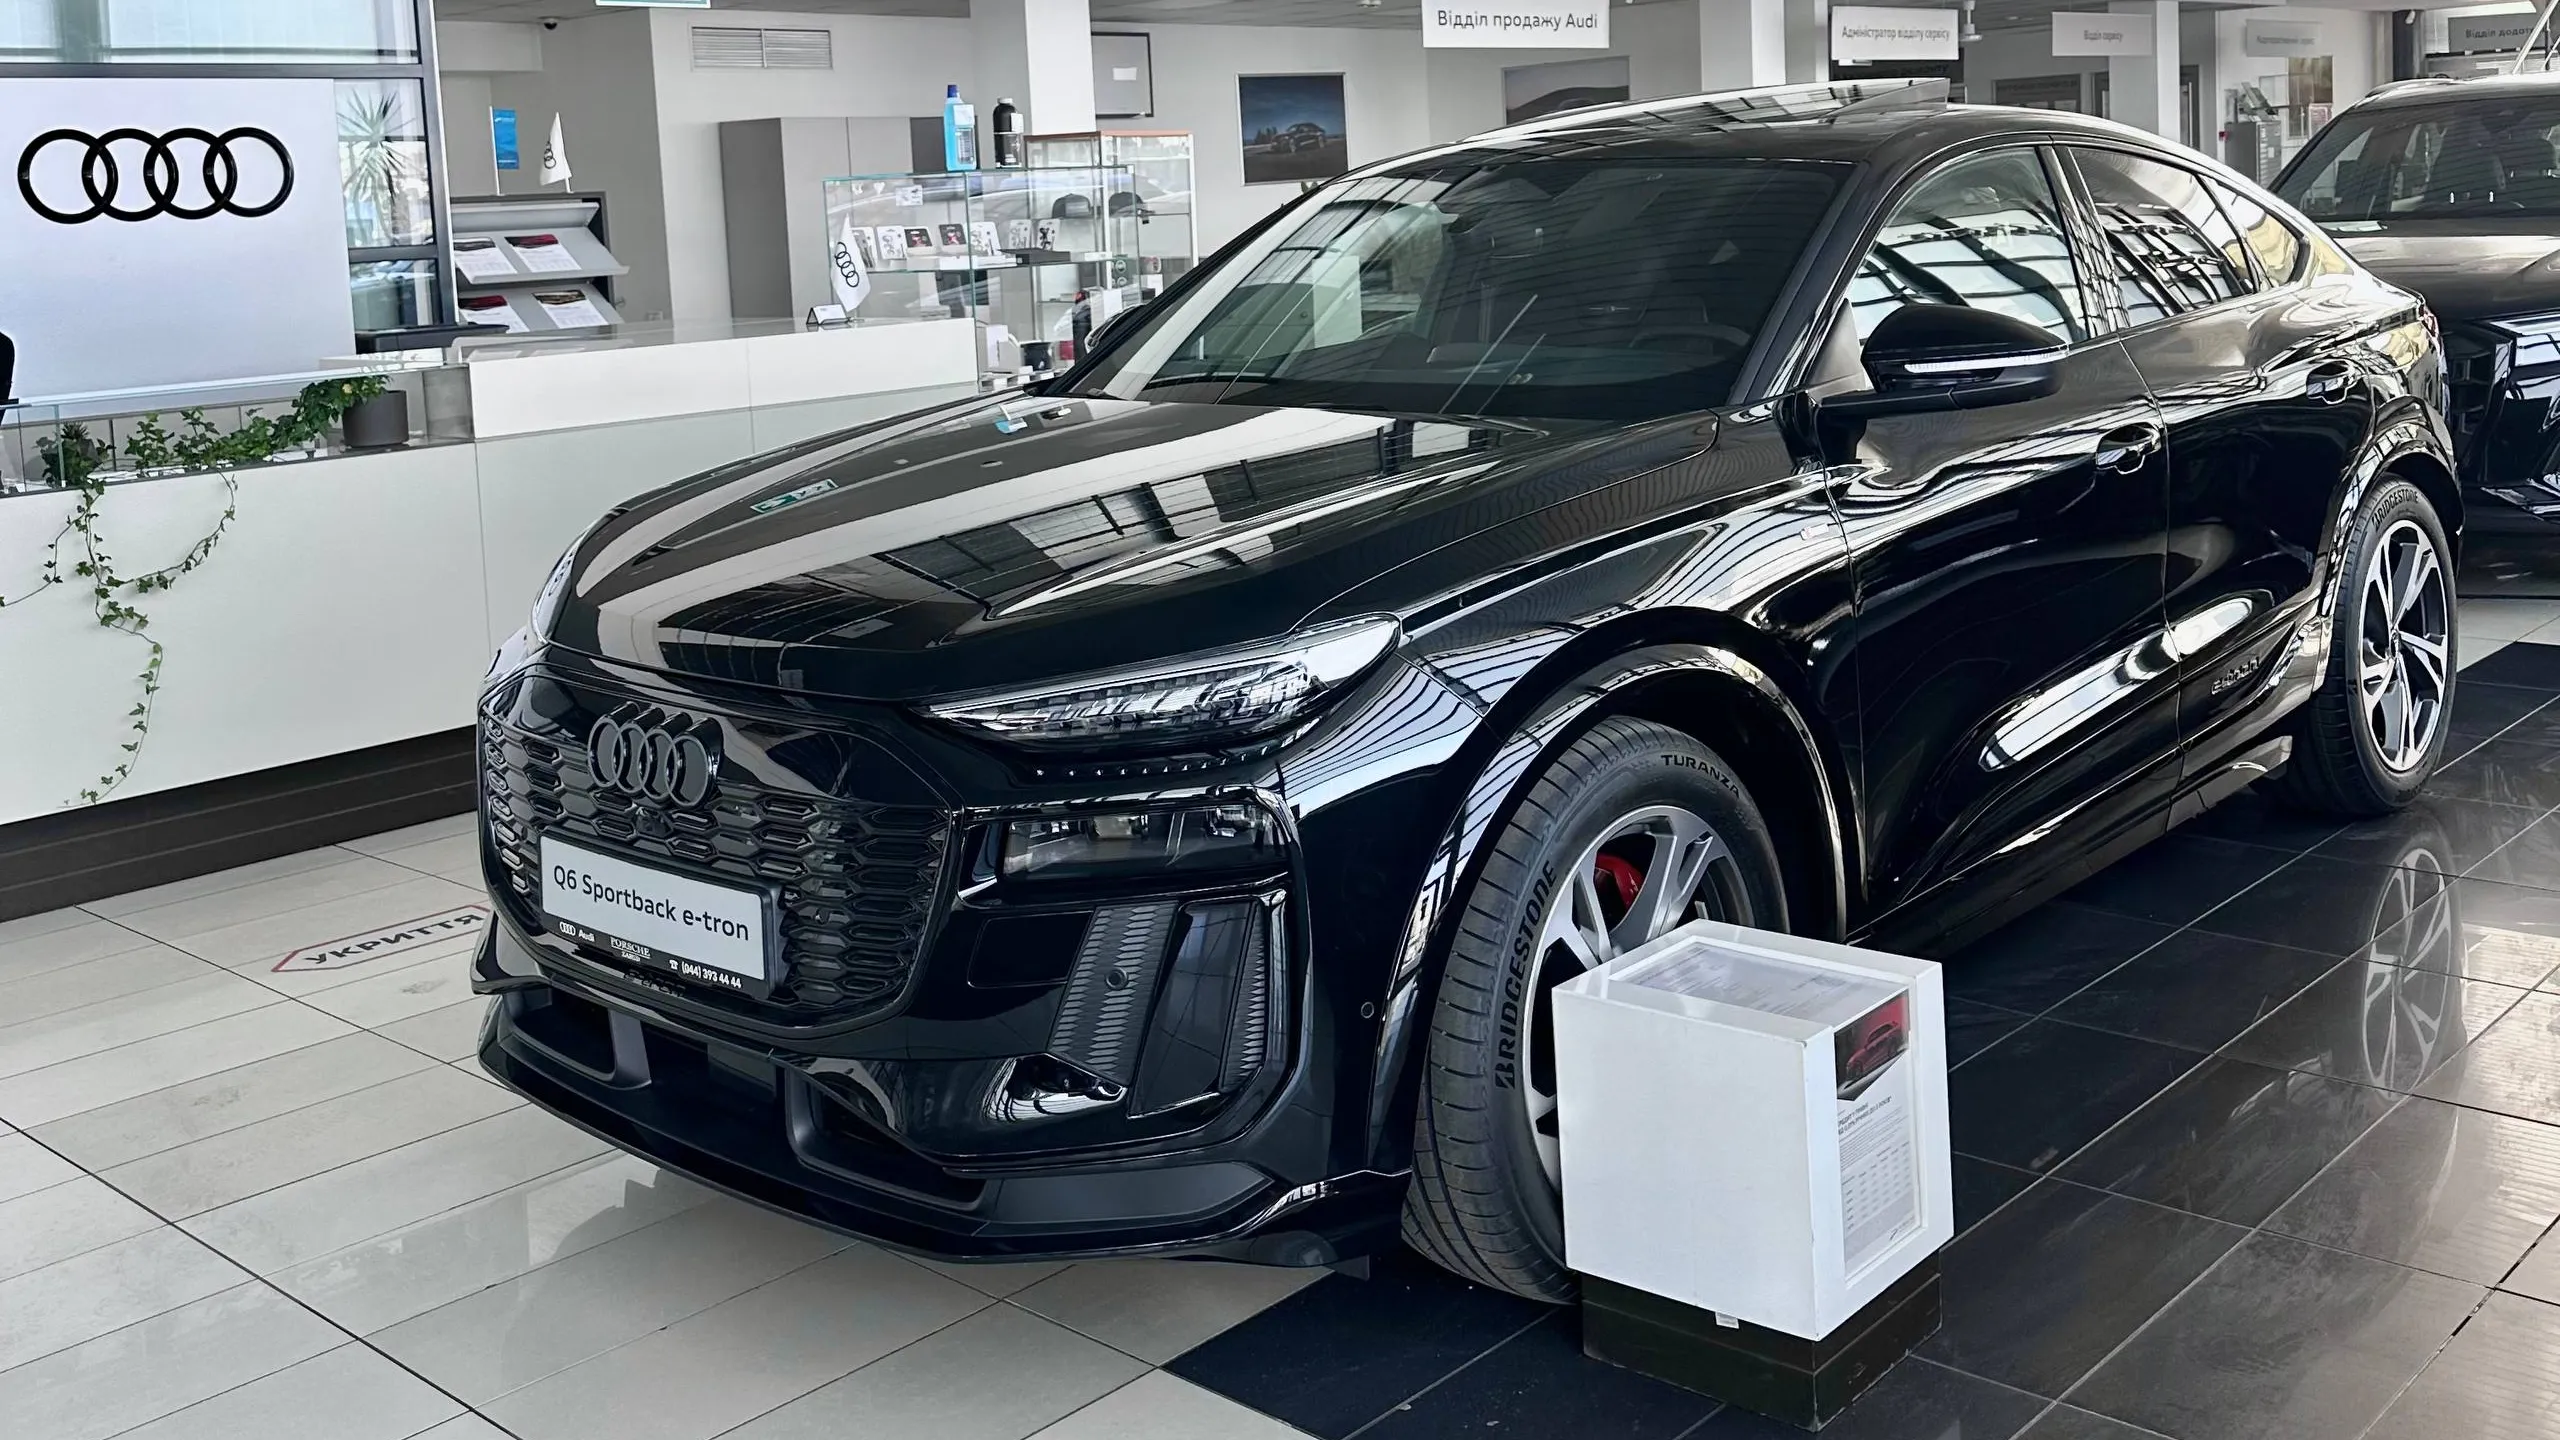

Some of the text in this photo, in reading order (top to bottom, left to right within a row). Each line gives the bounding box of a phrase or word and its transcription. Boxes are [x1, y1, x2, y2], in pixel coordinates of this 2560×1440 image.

[1438, 10, 1598, 31] Відділ продажу Audi
[2465, 28, 2496, 38] Відділ
[2371, 488, 2419, 531] BRIDGESTONE
[1660, 754, 1740, 799] TURANZA
[553, 865, 749, 941] Q6 Sportback e-tron
[303, 914, 485, 964] УКРИТТЯ
[578, 929, 595, 942] Audi
[610, 937, 650, 957] PORSCHE
[681, 961, 742, 989] (044) 393 44 44
[1495, 860, 1557, 1090] BRIDGESTONE
